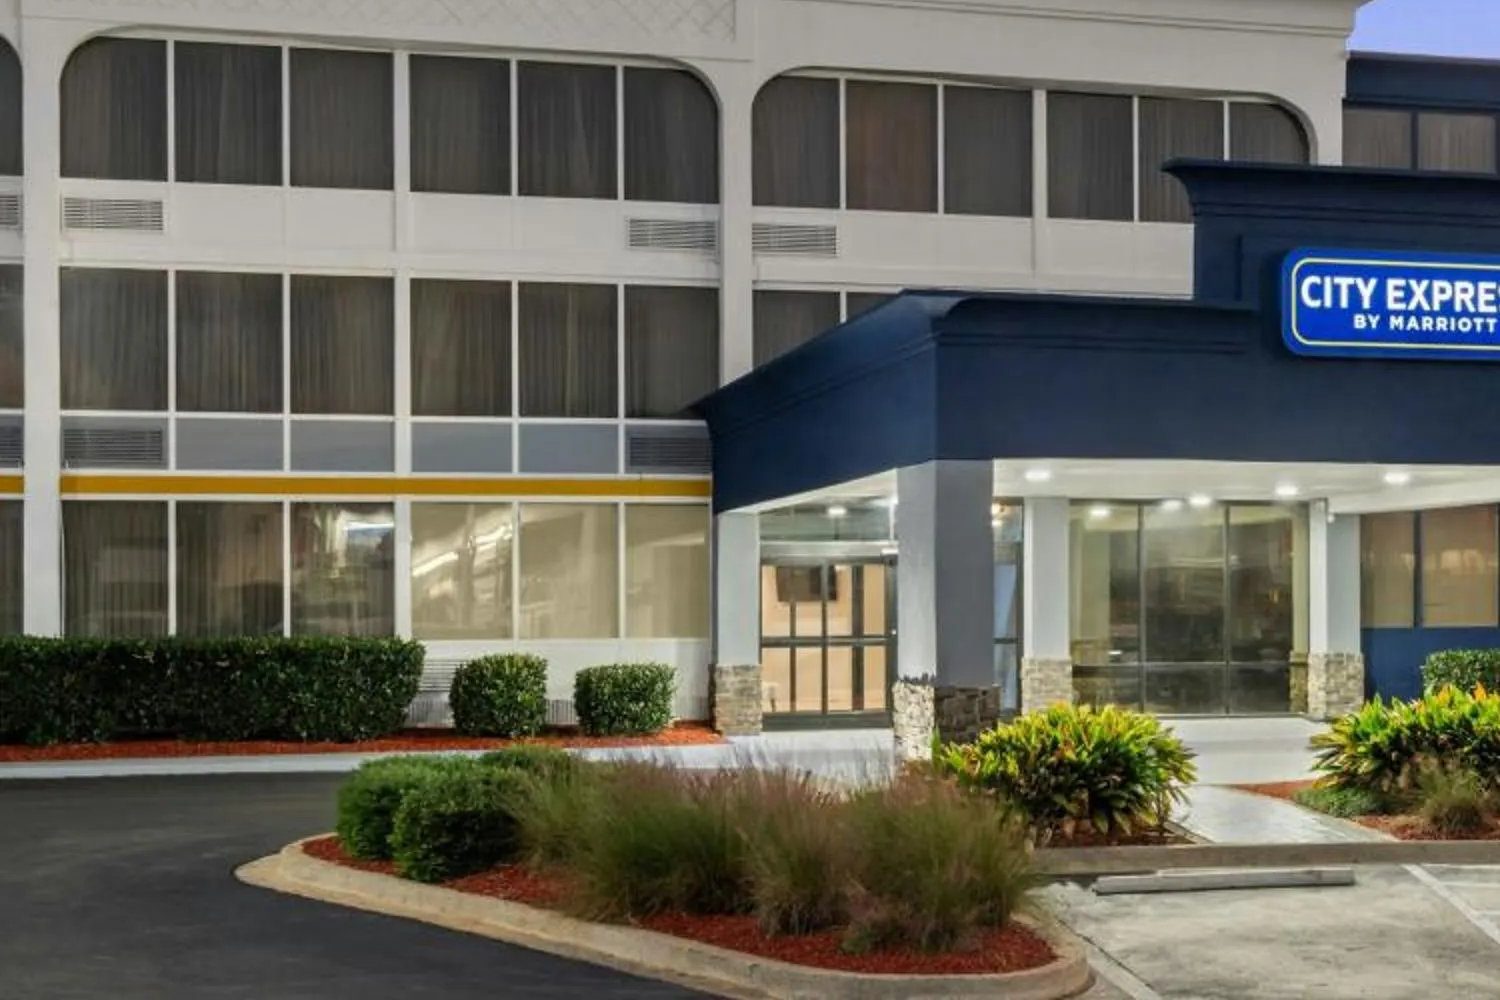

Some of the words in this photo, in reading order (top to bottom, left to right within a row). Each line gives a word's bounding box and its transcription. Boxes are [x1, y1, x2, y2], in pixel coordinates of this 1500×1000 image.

[1301, 275, 1377, 309] CITY
[1353, 314, 1380, 330] BY
[1390, 315, 1497, 333] MARRIOTT
